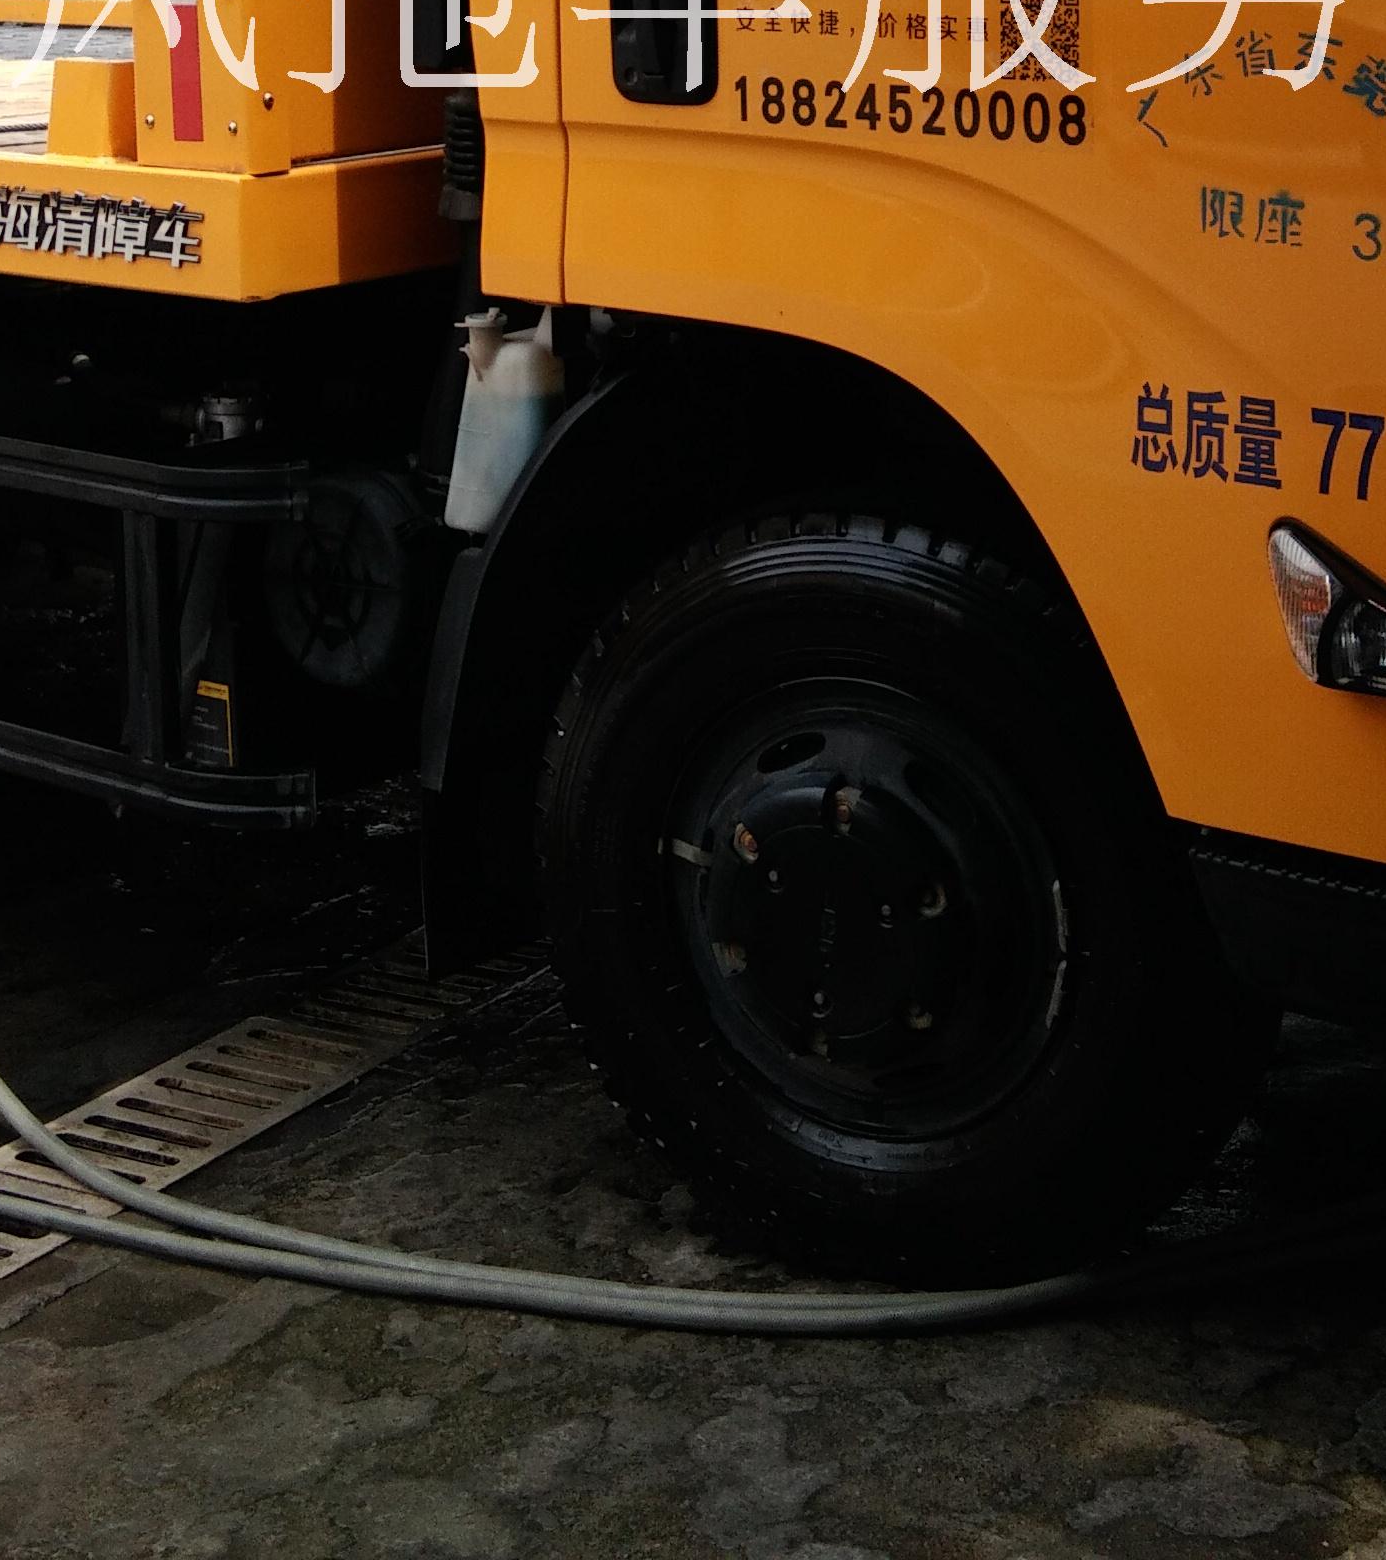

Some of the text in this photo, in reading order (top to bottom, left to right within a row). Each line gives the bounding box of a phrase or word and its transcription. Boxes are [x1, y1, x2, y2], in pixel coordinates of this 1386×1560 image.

[734, 75, 1087, 146] 18824520008
[1201, 185, 1306, 247] 限座
[1131, 381, 1282, 489] 总质量
